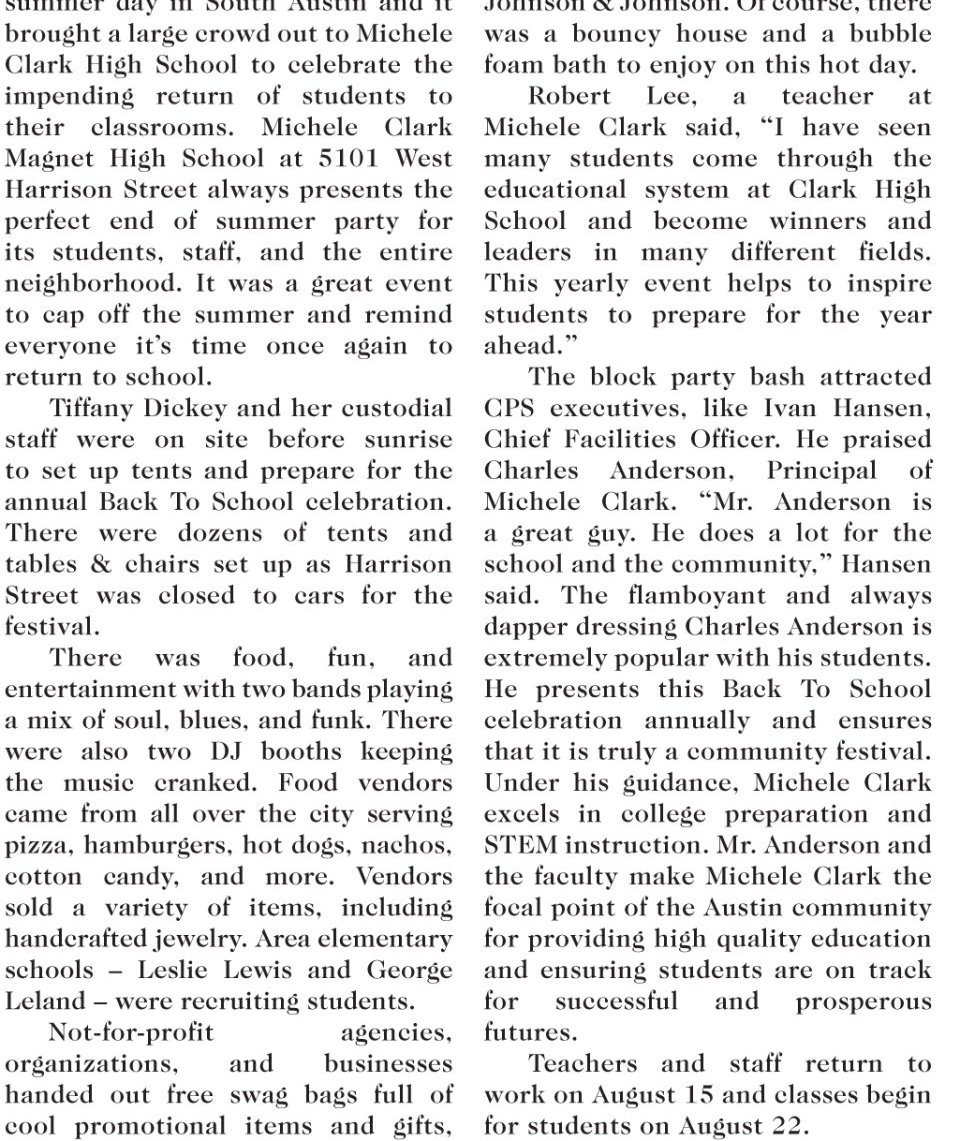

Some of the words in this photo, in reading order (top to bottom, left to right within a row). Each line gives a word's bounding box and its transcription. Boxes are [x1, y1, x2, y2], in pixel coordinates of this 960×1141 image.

[5, 1115, 55, 1135] cool
[74, 1114, 225, 1140] promotional
[245, 1116, 312, 1135] items
[330, 1115, 375, 1135] and
[393, 1114, 452, 1140] gifts,
[485, 1114, 519, 1135] for
[528, 1114, 631, 1135] students
[640, 1121, 669, 1135] on
[679, 1116, 763, 1140] August
[772, 1115, 809, 1135] 22.
